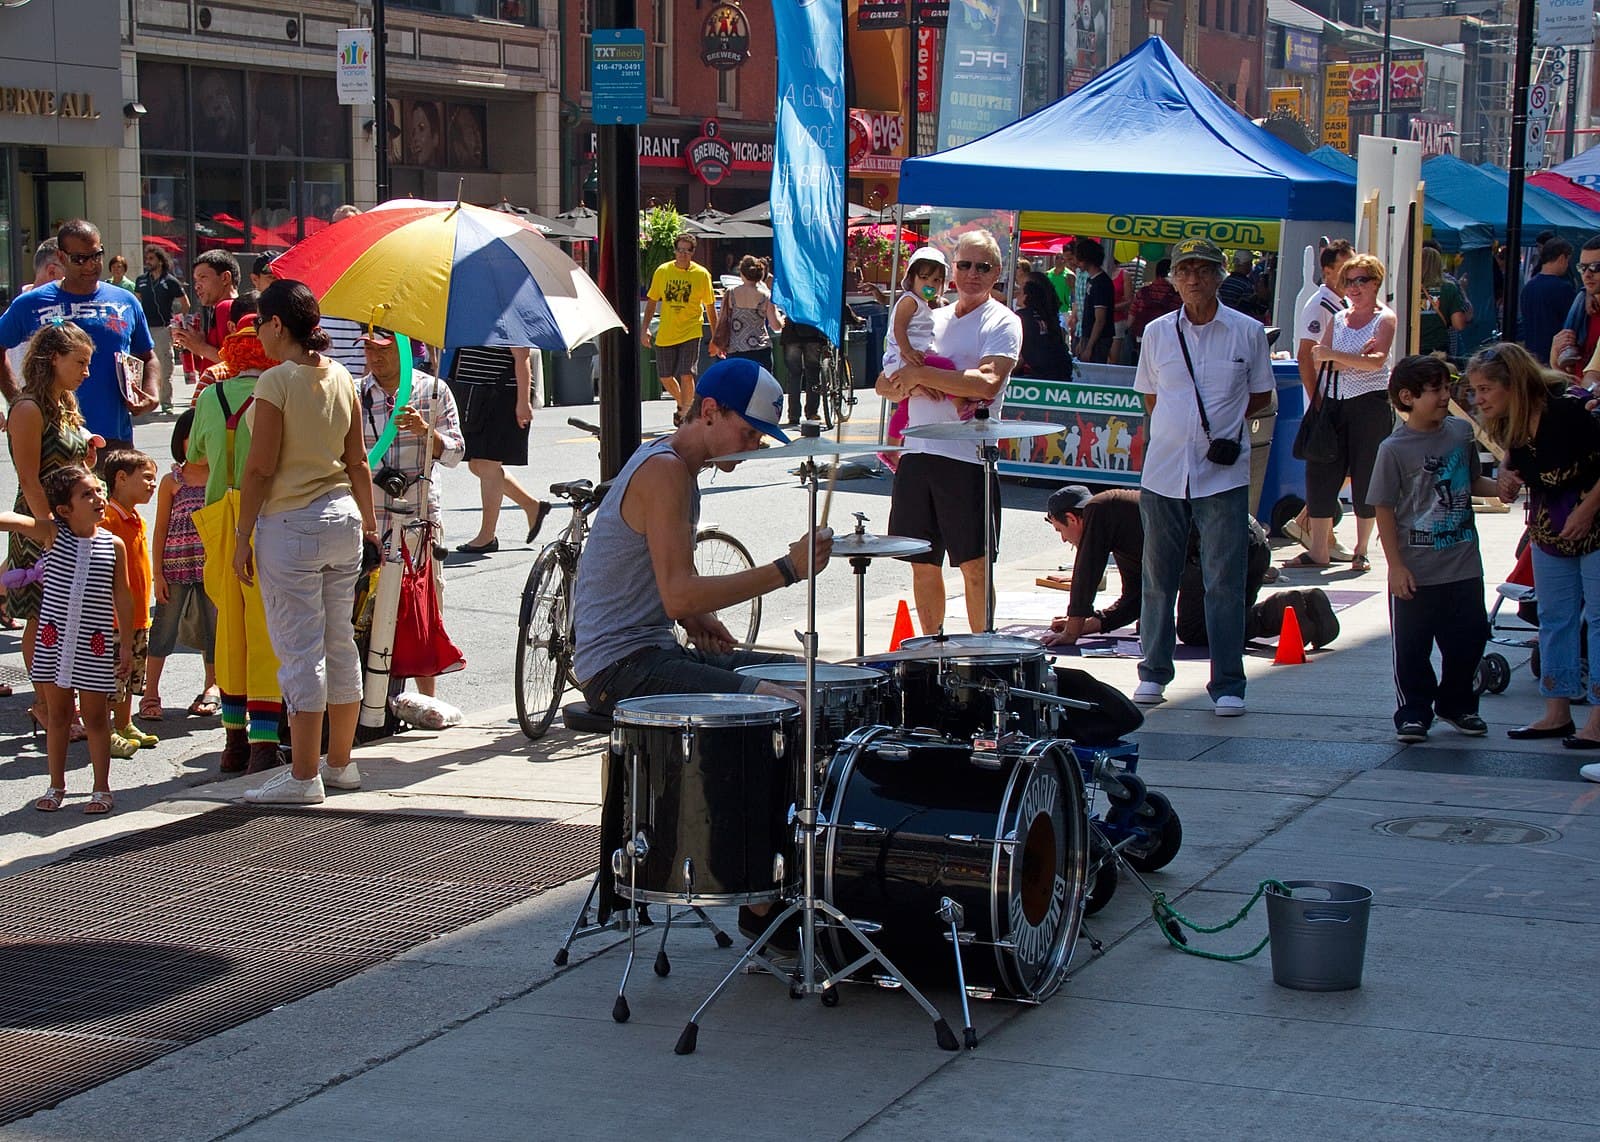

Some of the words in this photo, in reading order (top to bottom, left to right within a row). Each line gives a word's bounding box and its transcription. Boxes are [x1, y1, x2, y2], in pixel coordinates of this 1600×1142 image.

[870, 11, 899, 19] GAMES
[931, 9, 949, 17] GAM
[706, 51, 741, 61] BREWERS
[60, 92, 101, 120] ALL
[708, 123, 714, 137] 3
[1324, 122, 1346, 130] CASH
[694, 142, 730, 165] BREWERS
[1045, 388, 1071, 404] NA
[1076, 390, 1142, 409] MESMA
